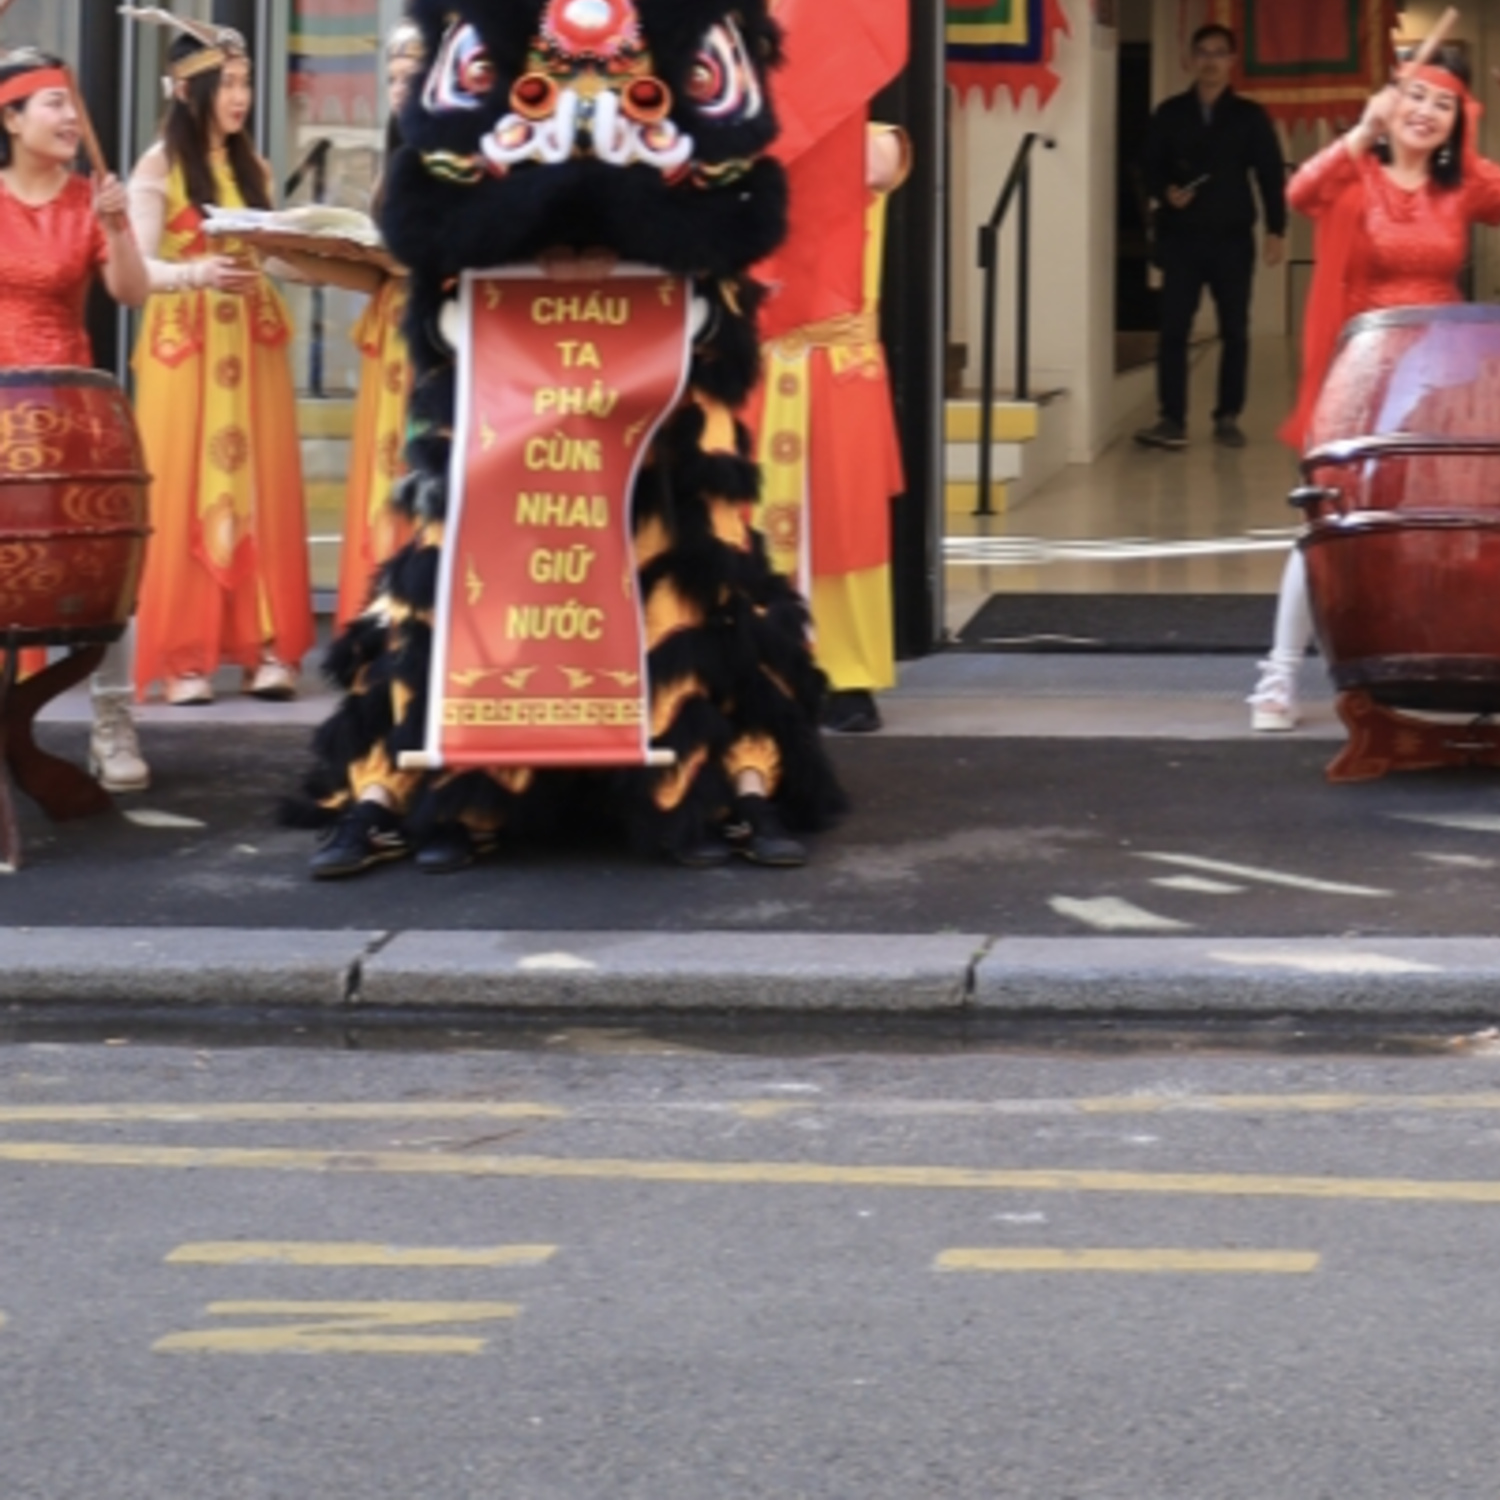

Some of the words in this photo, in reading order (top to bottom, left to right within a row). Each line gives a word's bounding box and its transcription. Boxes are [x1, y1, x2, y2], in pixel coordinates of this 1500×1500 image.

[531, 290, 629, 326] CHÁU
[555, 340, 601, 369] TA
[529, 544, 595, 584] GIỮ
[504, 598, 605, 640] NƯỚC
